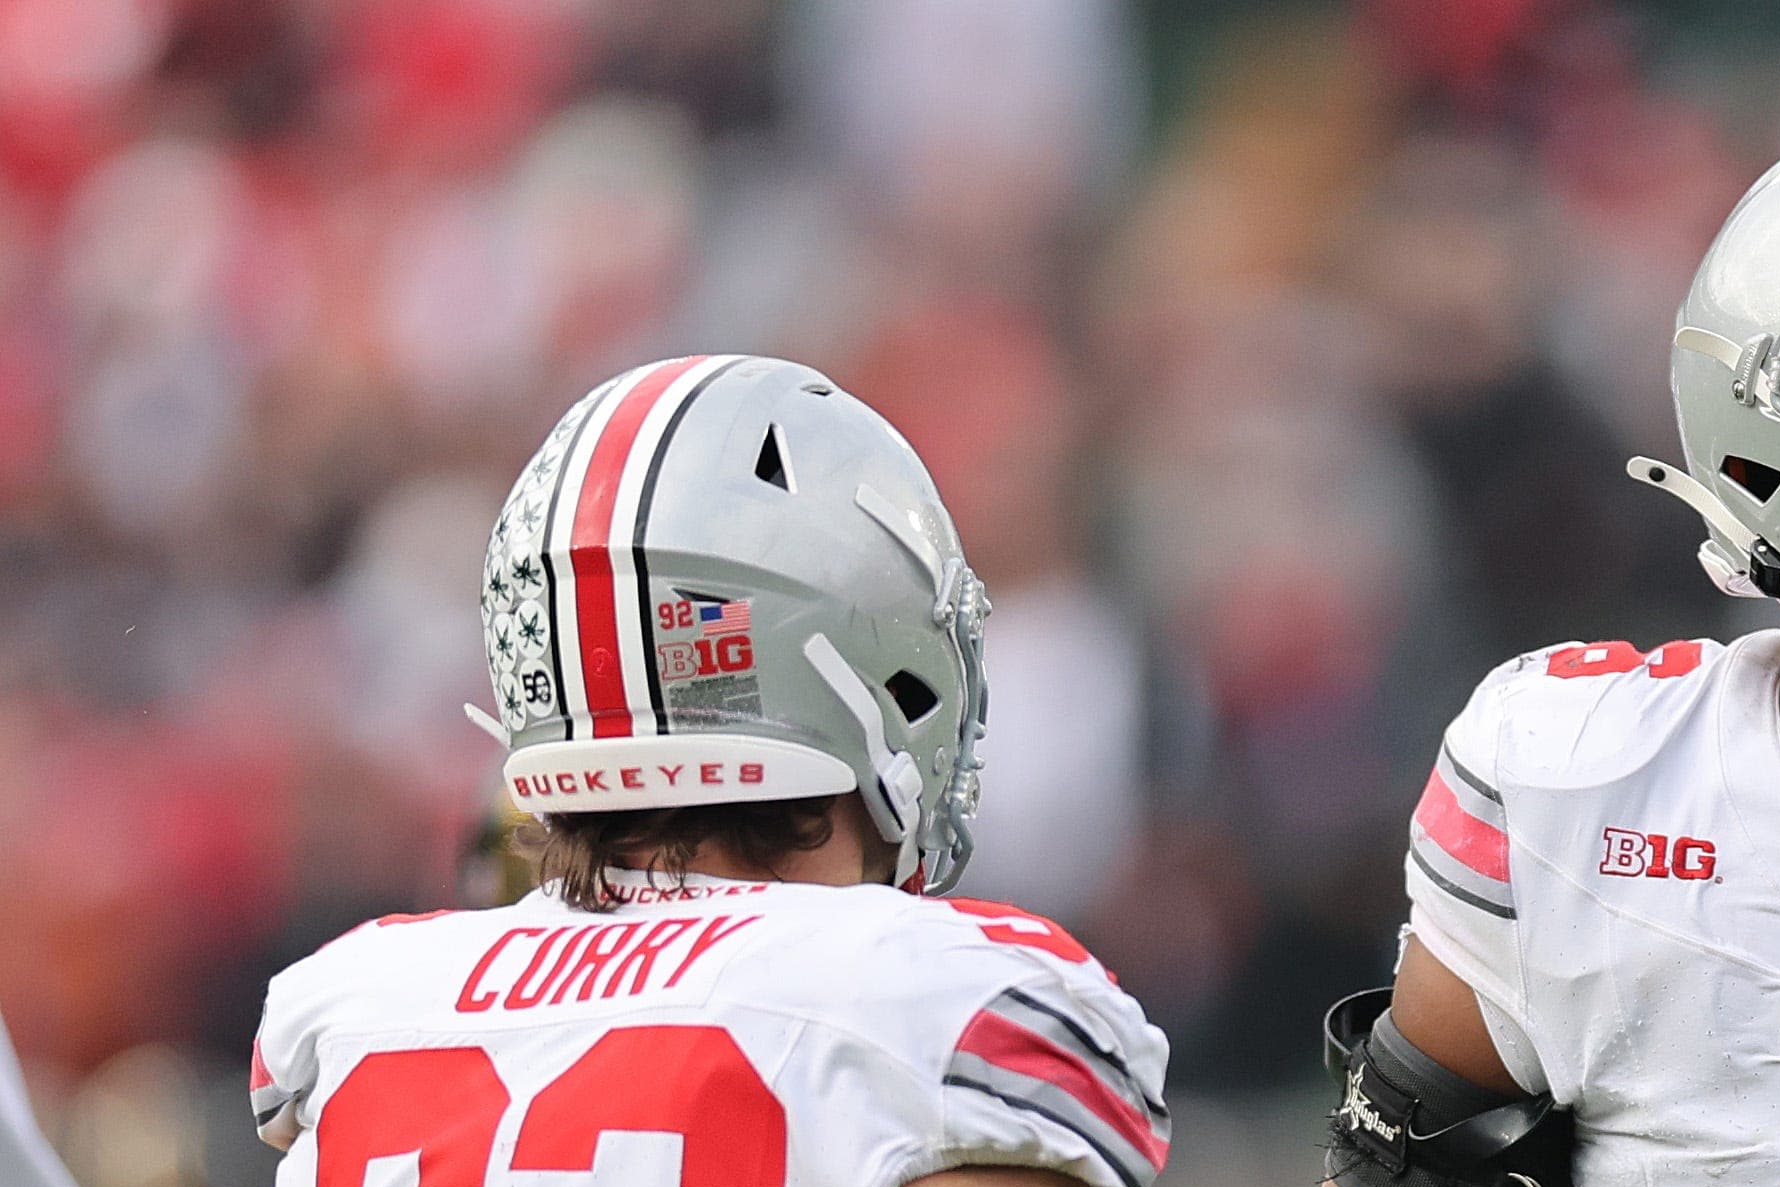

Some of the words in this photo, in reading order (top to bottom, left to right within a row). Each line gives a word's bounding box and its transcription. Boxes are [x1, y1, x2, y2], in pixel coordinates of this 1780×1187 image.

[658, 600, 694, 630] 92
[513, 763, 764, 797] BUCKEYES
[600, 883, 769, 904] BUCKEYES
[455, 914, 766, 1013] CURRY
